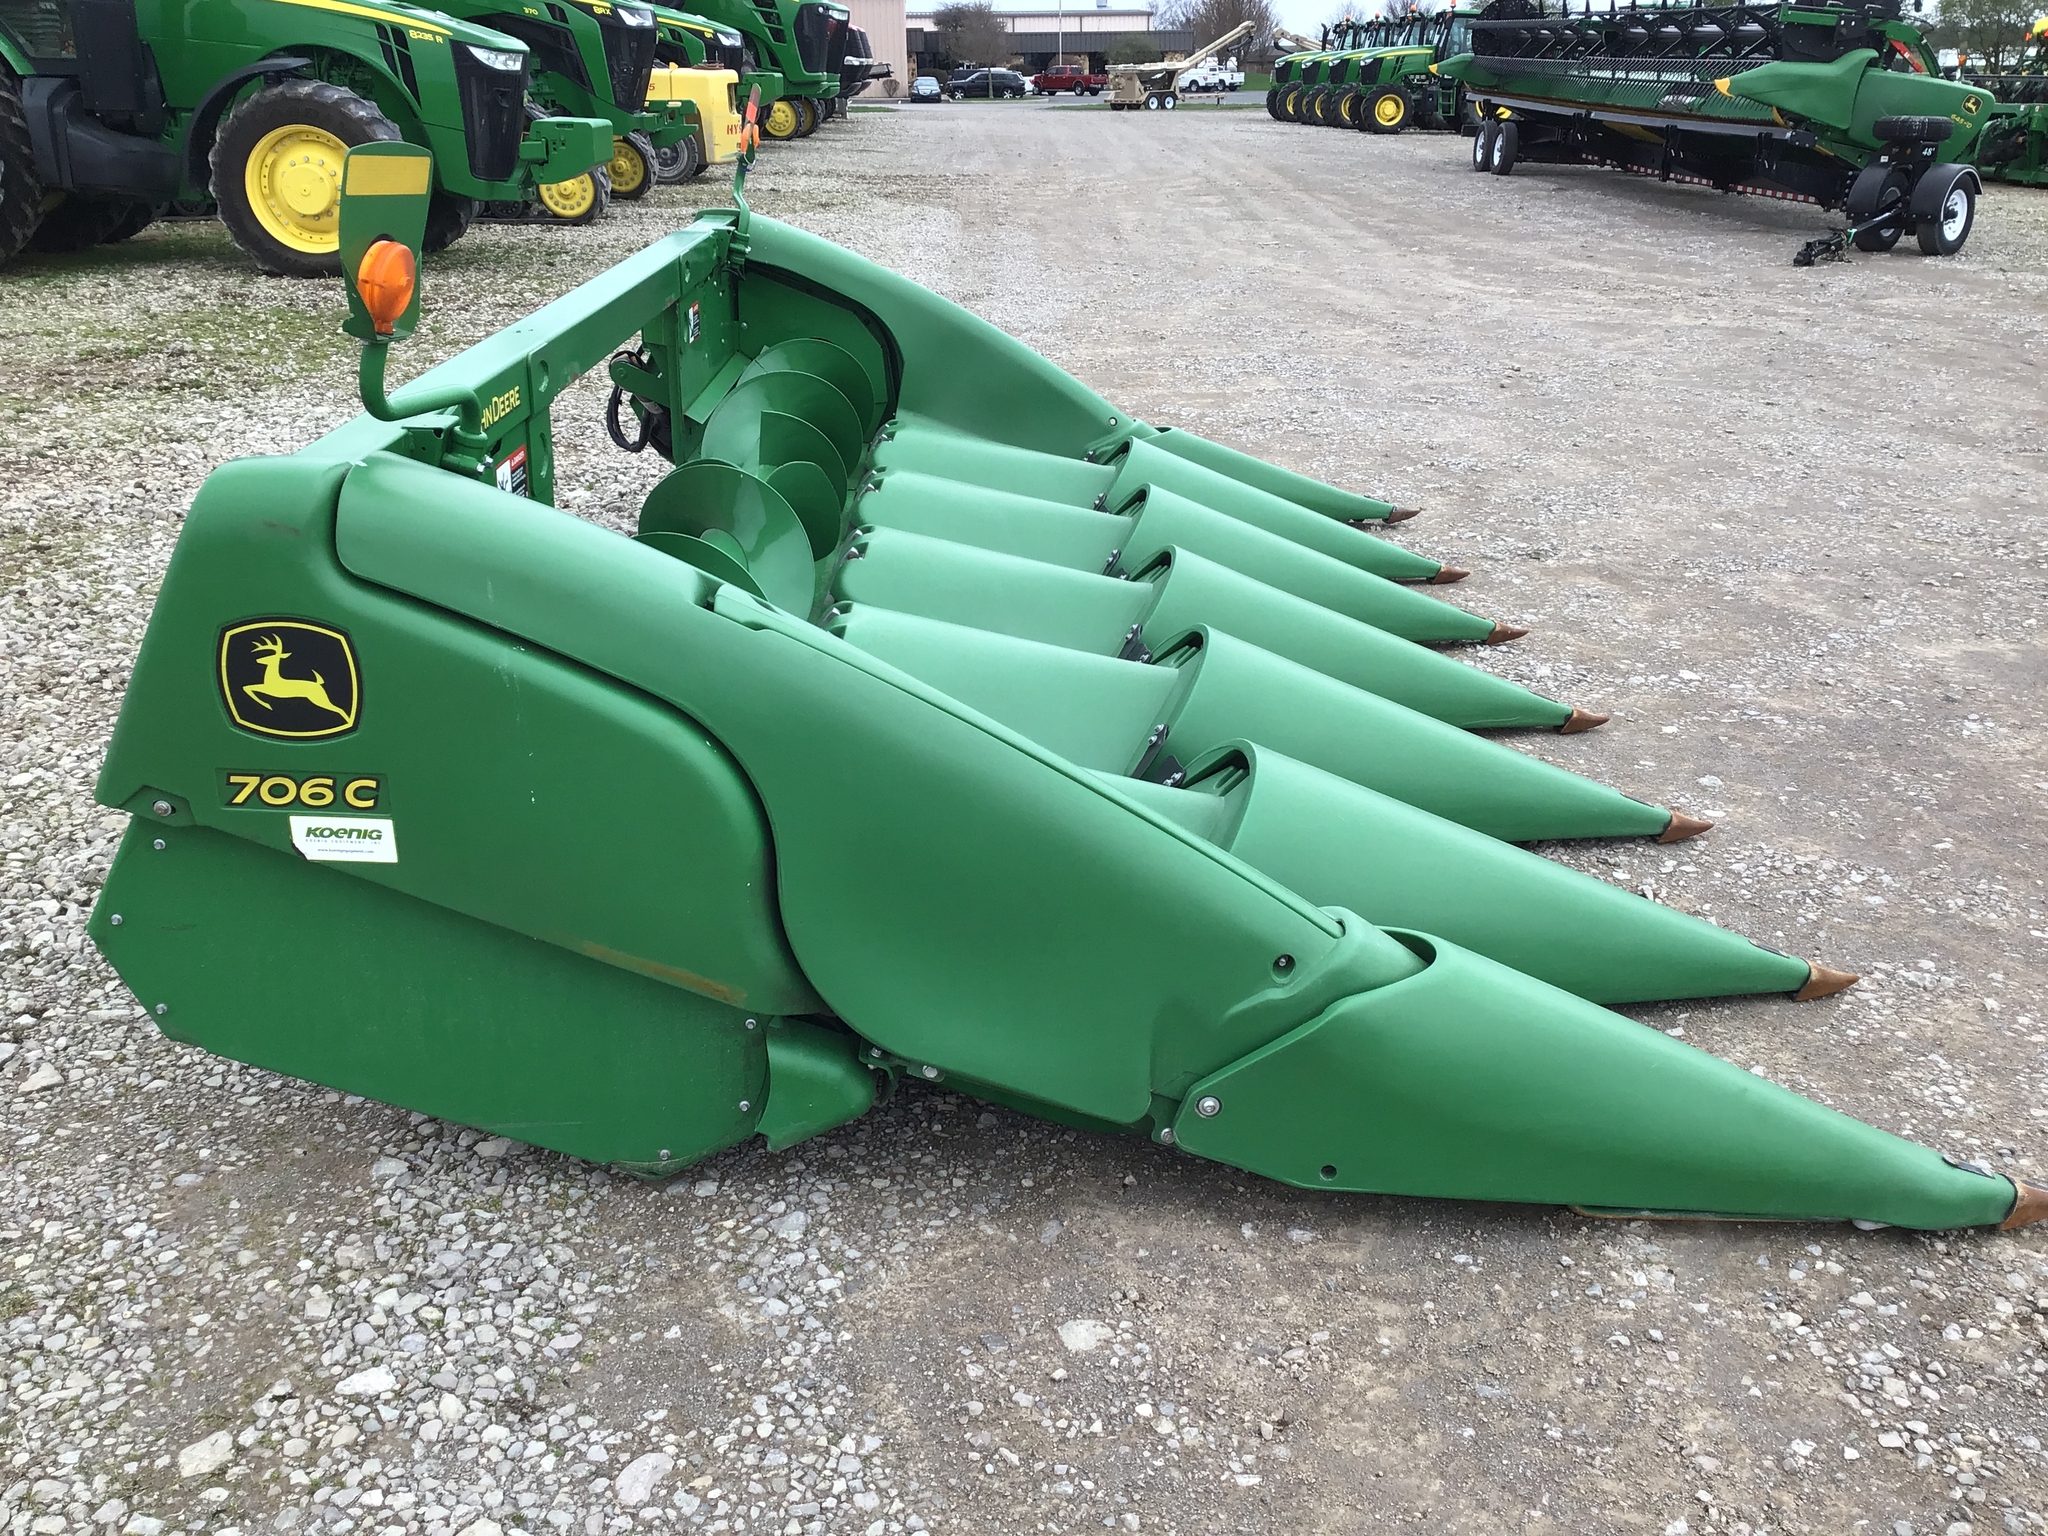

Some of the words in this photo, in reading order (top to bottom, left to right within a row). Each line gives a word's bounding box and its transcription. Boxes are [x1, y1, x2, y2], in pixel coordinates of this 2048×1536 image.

[435, 35, 443, 44] R
[492, 385, 520, 423] DEERE
[226, 774, 336, 808] 706
[342, 776, 380, 809] C
